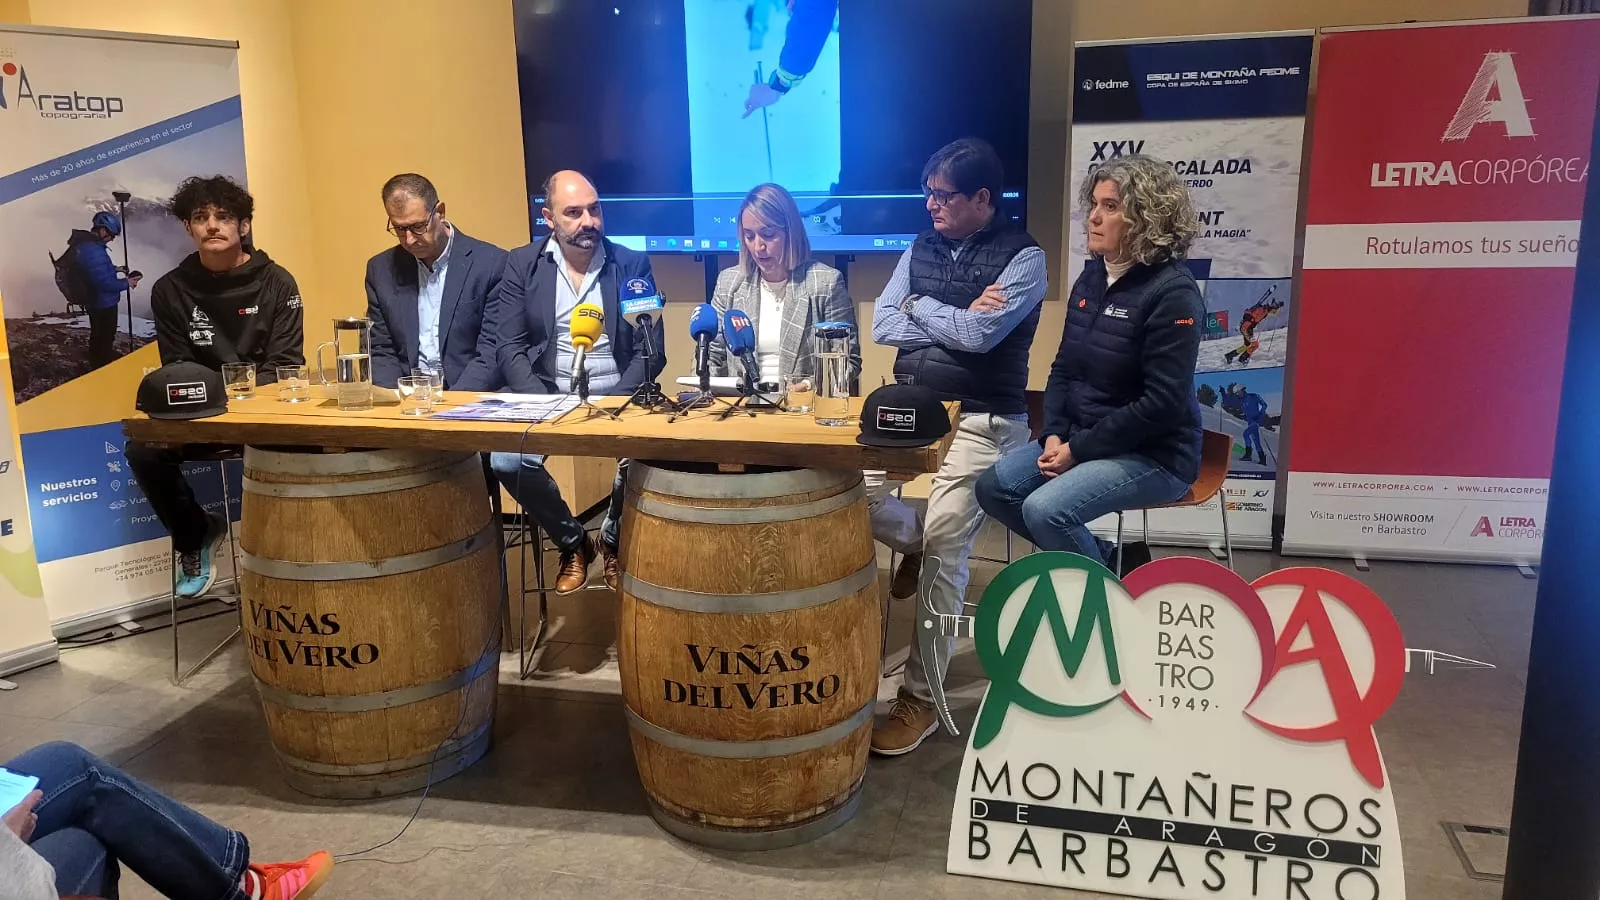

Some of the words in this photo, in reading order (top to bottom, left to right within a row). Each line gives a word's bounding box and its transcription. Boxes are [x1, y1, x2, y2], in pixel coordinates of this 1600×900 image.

[1095, 79, 1130, 90] fedme
[1146, 72, 1180, 82] ESQUI
[1200, 67, 1257, 80] MONTAÑA
[17, 63, 124, 118] Aratop
[50, 168, 61, 177] de
[61, 163, 74, 173] 20
[75, 157, 96, 169] años
[96, 153, 107, 161] de
[107, 136, 150, 157] experiencia
[151, 133, 161, 141] en
[161, 129, 170, 137] el
[170, 121, 193, 134] sector
[1089, 140, 1145, 161] XXV
[1365, 236, 1473, 255] Rotulamos
[1480, 236, 1512, 253] tus
[1517, 235, 1580, 253] sueño
[731, 316, 750, 328] hit
[41, 476, 97, 492] Nuestros
[42, 490, 99, 507] servicios
[1313, 481, 1434, 492] WWW.LETRACORPOREA.COM
[1457, 486, 1548, 494] WWW.LETRACORPOR
[1310, 510, 1335, 520] Visita
[1337, 511, 1371, 521] nuestro
[1373, 513, 1434, 523] SHOWROOM
[1361, 526, 1374, 534] en
[1377, 524, 1427, 536] Barbastro
[1499, 517, 1537, 527] LETRA
[249, 599, 341, 636] VIÑAS
[1159, 600, 1215, 630] BAR
[276, 639, 379, 670] VERO
[684, 643, 810, 675] VIÑAS
[1158, 631, 1214, 660] BAS
[1154, 662, 1215, 691] TRO
[662, 678, 733, 709] DEL
[732, 674, 841, 710] VERO
[970, 757, 1382, 839] MONTAÑEROS
[971, 800, 1030, 824] DE
[1113, 814, 1381, 868] ARAGÓN
[968, 820, 1381, 900] BARBASTRO
